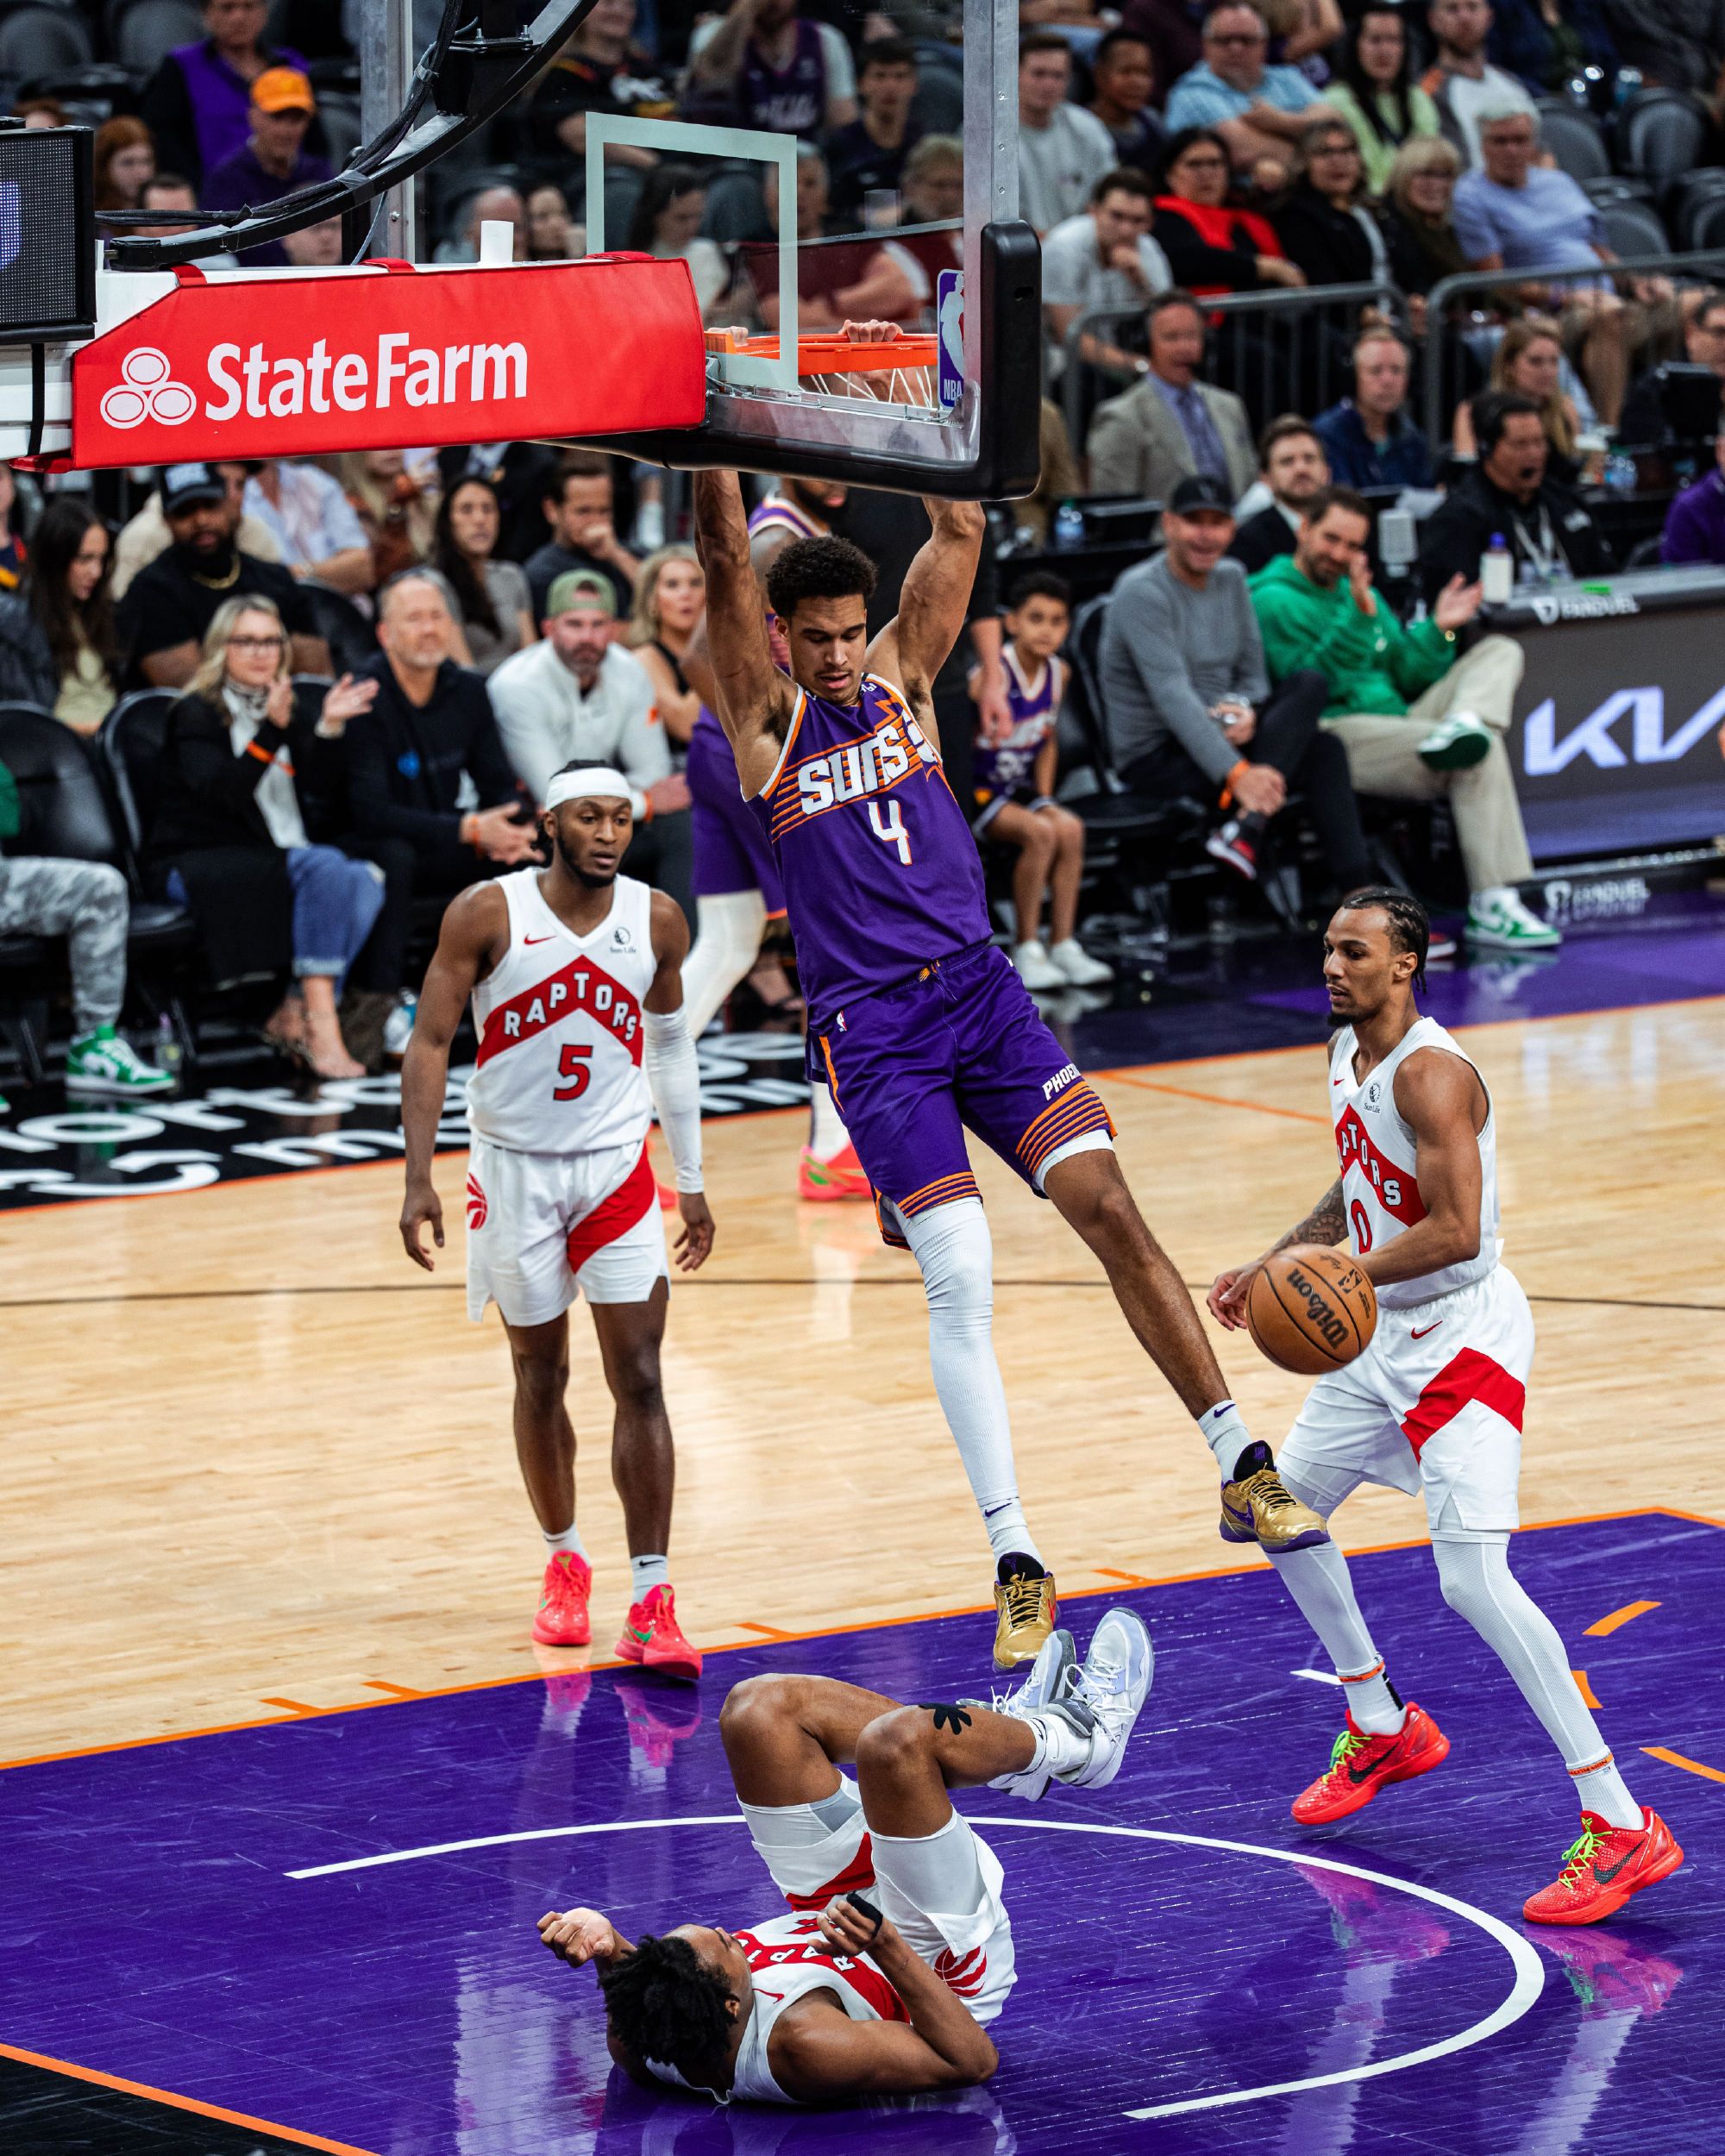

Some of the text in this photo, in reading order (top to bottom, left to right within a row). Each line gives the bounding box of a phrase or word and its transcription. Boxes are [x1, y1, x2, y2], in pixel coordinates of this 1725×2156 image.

[944, 378, 963, 401] NBA
[798, 725, 908, 814] SUNS
[867, 800, 912, 865] 4
[505, 972, 637, 1041] RAPTORS
[553, 1044, 593, 1100] 5
[1042, 1063, 1081, 1100] PHOE
[1351, 1199, 1372, 1255] 0
[1286, 1268, 1350, 1350] Wilson
